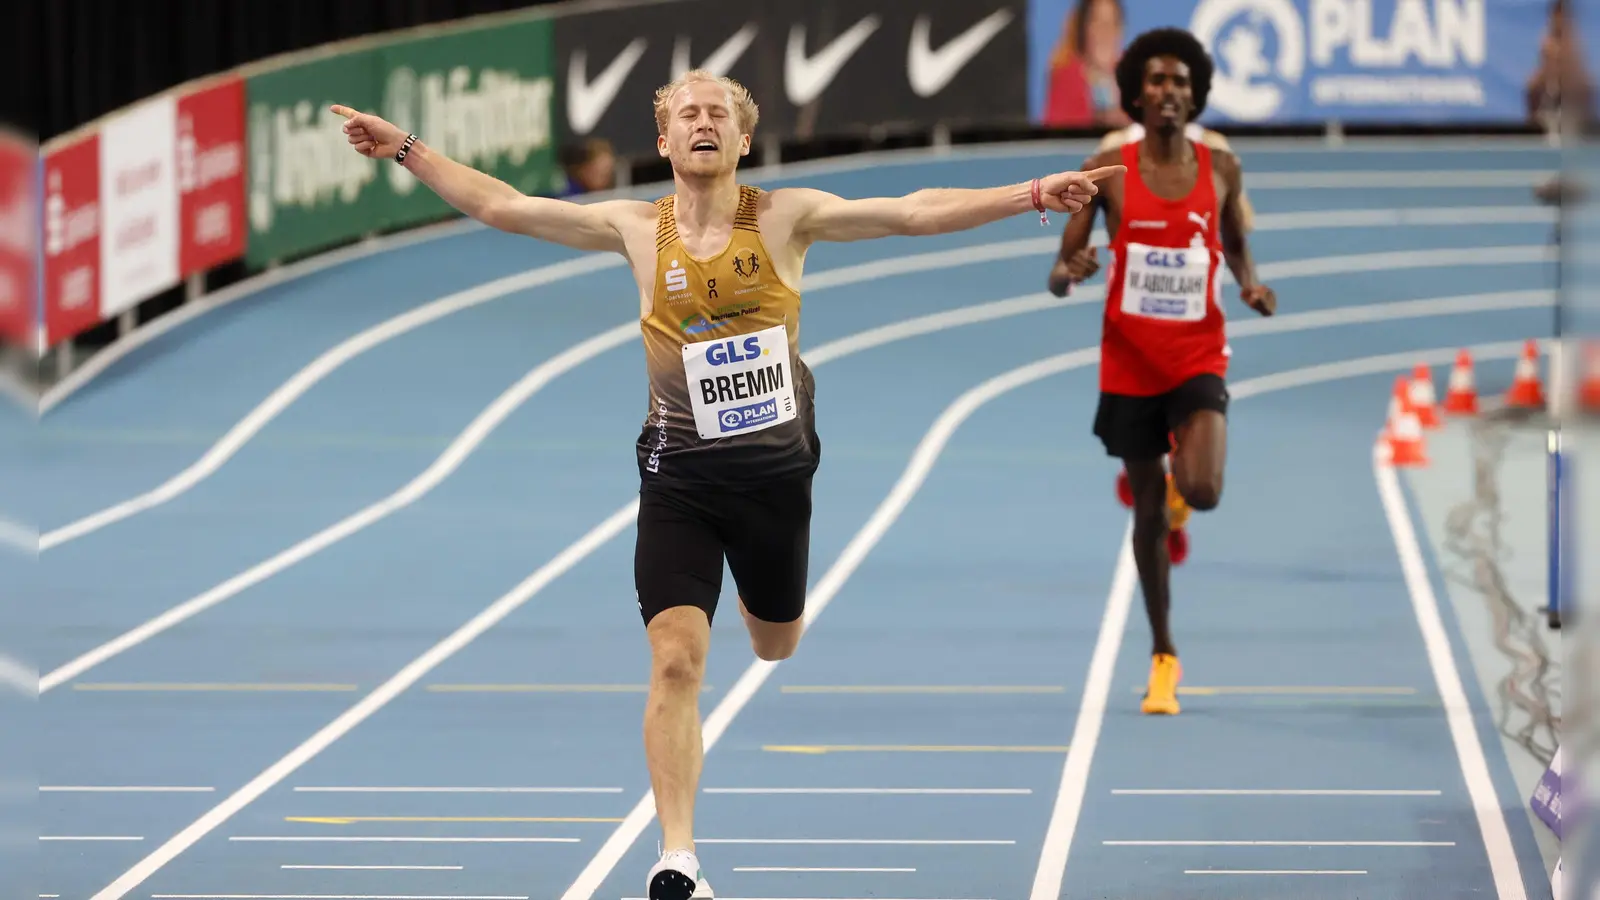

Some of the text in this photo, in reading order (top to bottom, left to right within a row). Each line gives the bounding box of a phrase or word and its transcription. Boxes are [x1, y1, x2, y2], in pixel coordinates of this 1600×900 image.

[1311, 0, 1486, 68] PLAN
[700, 362, 784, 405] BREMM
[744, 403, 776, 420] PLAN
[783, 396, 792, 412] 110
